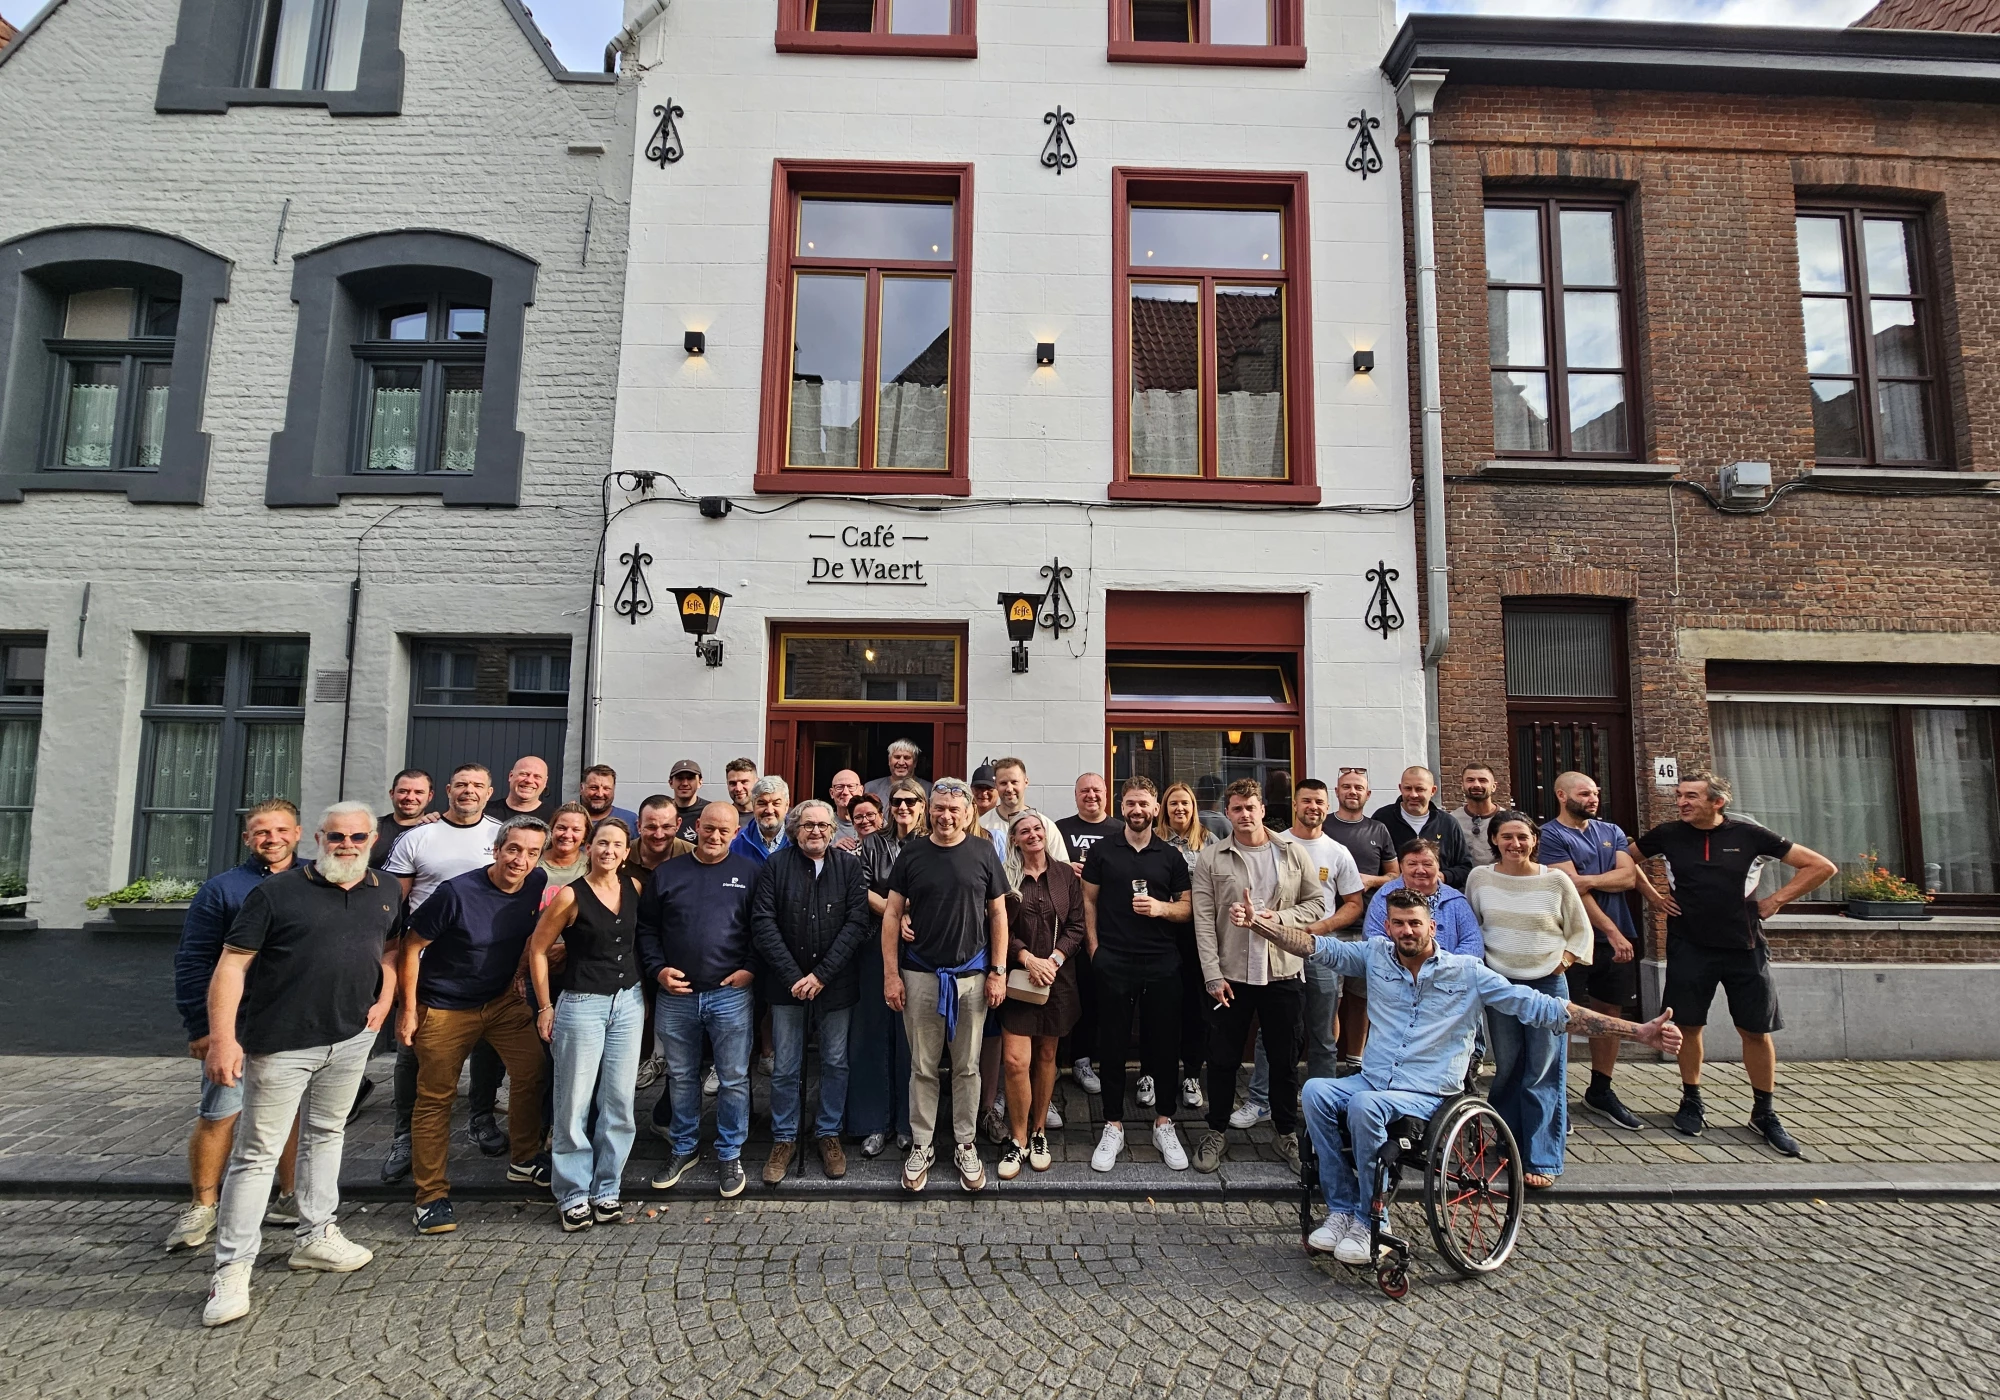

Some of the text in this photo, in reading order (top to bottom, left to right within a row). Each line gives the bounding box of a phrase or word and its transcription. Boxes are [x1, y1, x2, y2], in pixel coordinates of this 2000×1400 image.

[842, 524, 895, 548] Café
[811, 557, 924, 580] De Waert
[1658, 764, 1674, 778] 46
